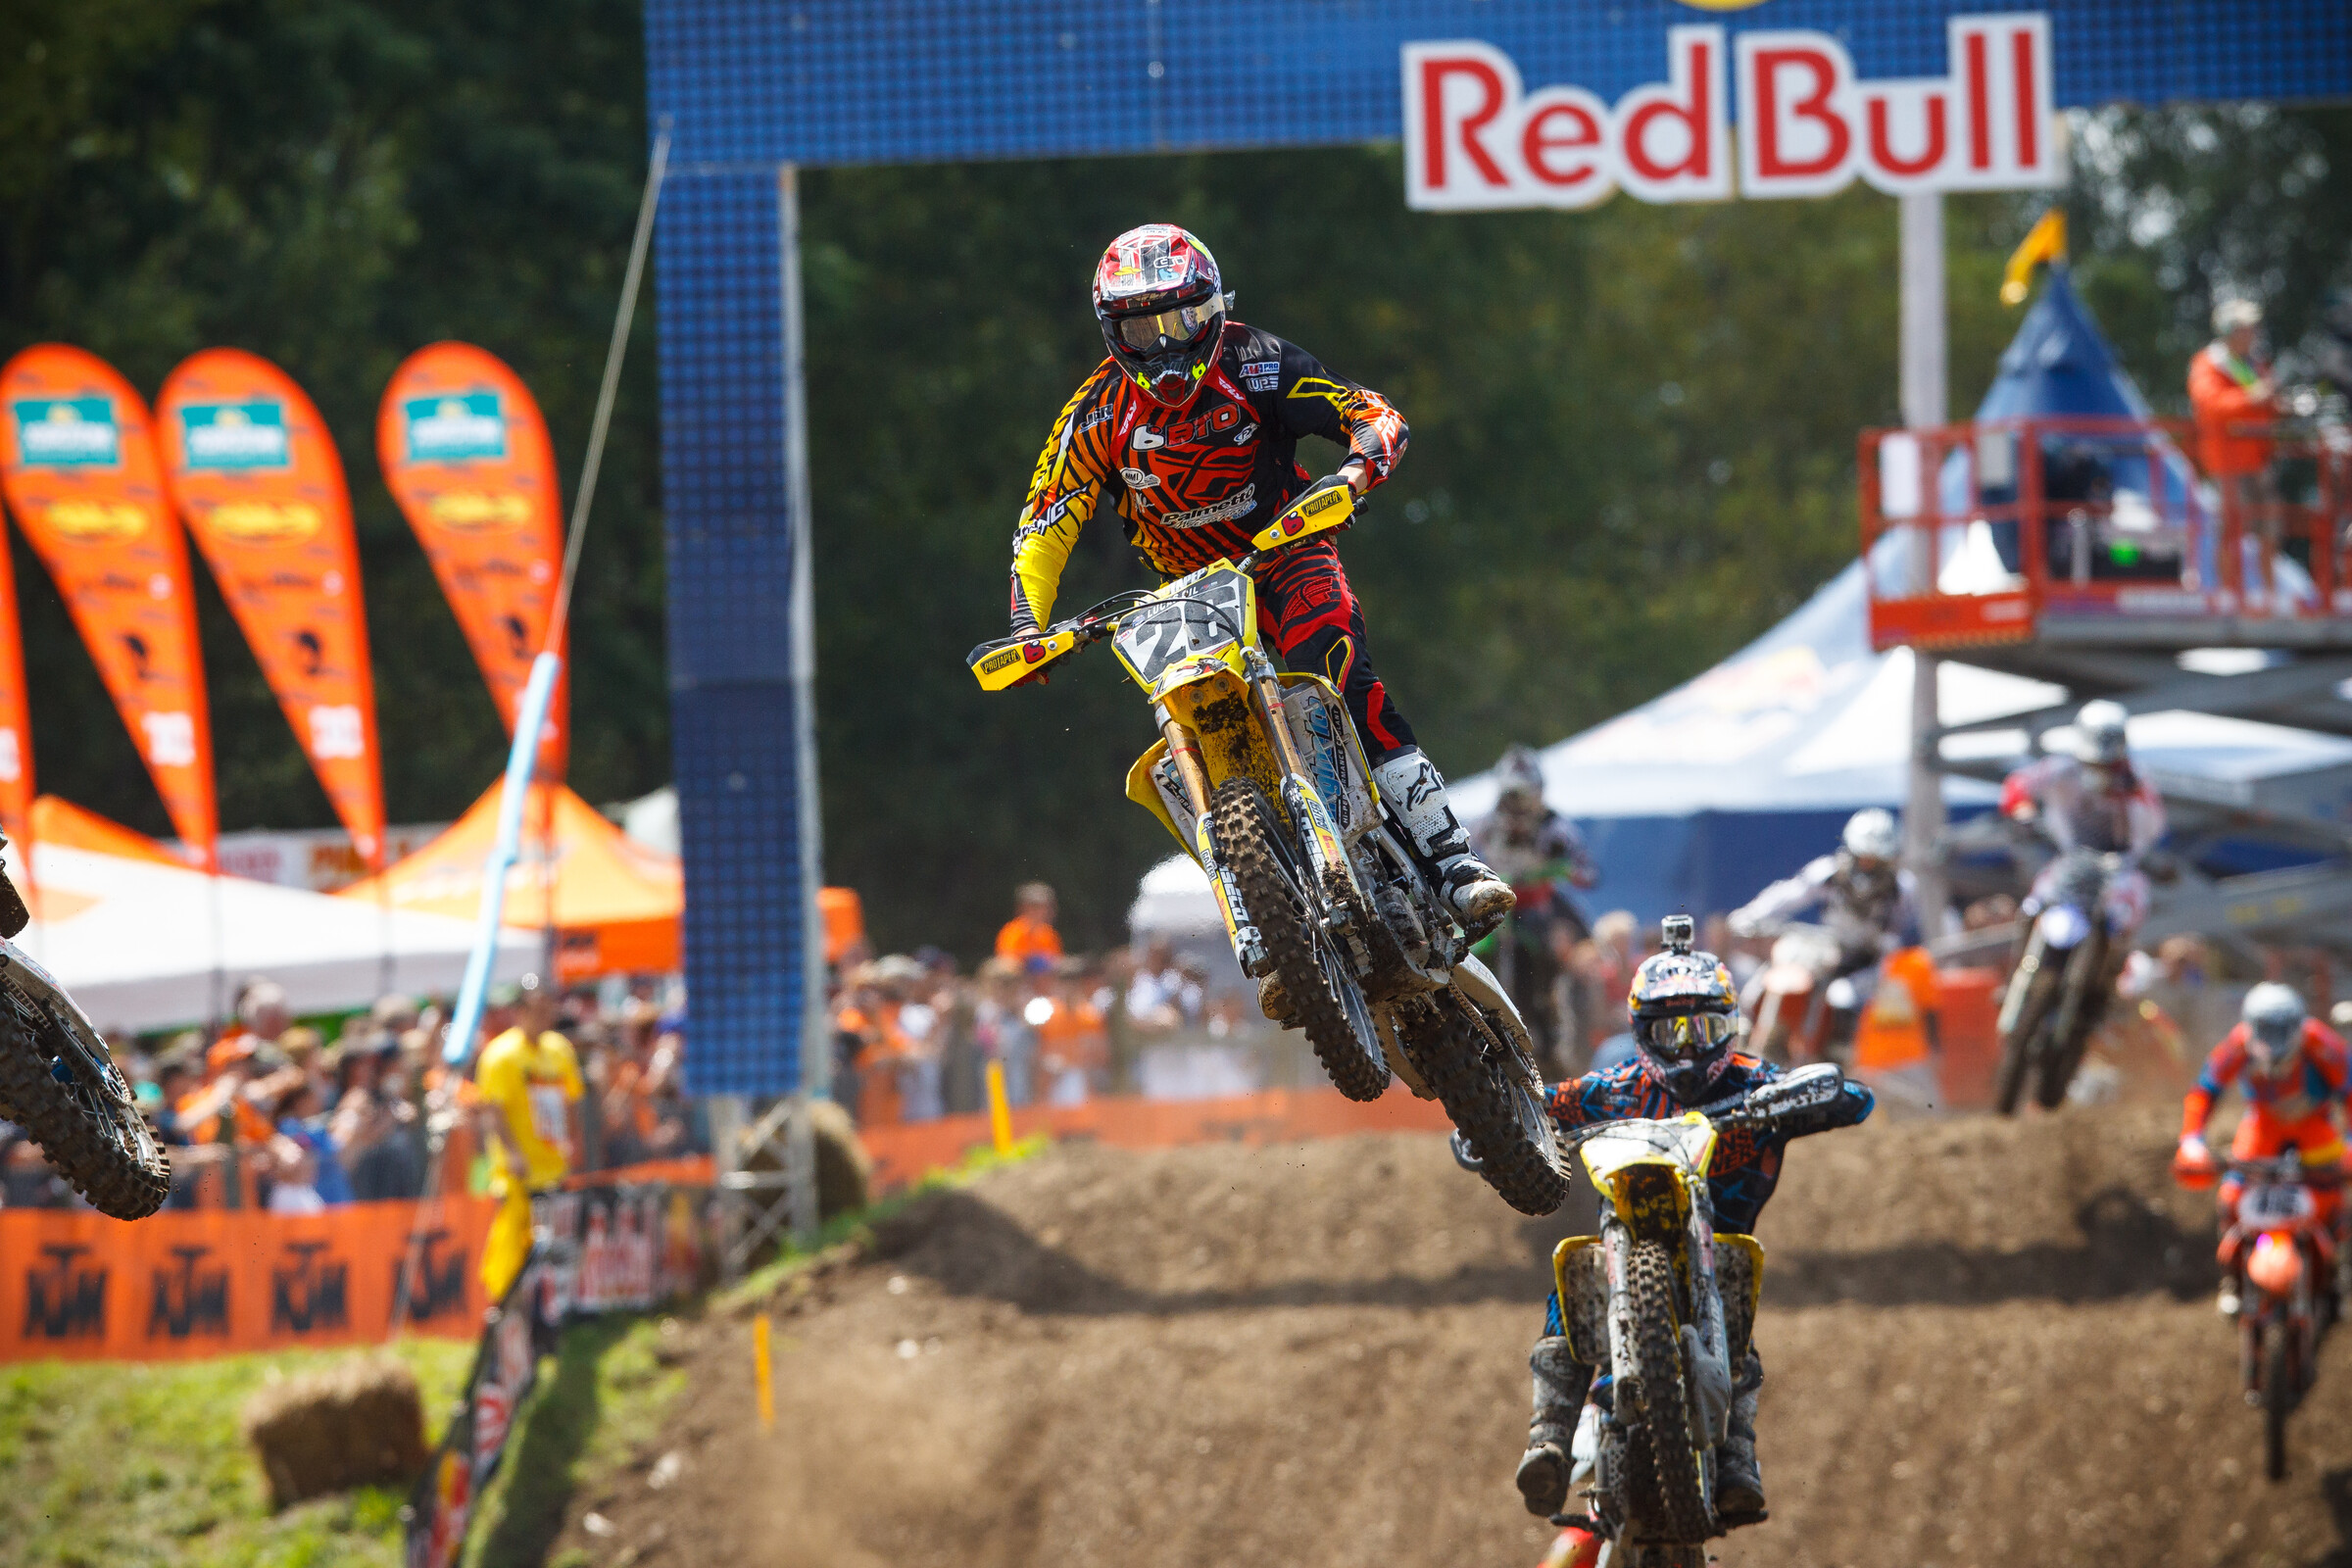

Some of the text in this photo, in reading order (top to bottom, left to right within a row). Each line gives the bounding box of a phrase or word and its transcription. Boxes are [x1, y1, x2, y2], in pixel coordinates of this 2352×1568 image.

[1419, 29, 2038, 191] Red Bull
[1240, 365, 1263, 376] AMA
[1218, 376, 1246, 401] FLY
[1118, 399, 1138, 437] FLY
[1166, 402, 1241, 448] BTO
[1162, 485, 1254, 523] Palmetto
[1304, 492, 1338, 515] PROTAPER
[984, 651, 1016, 672] PROTAPER
